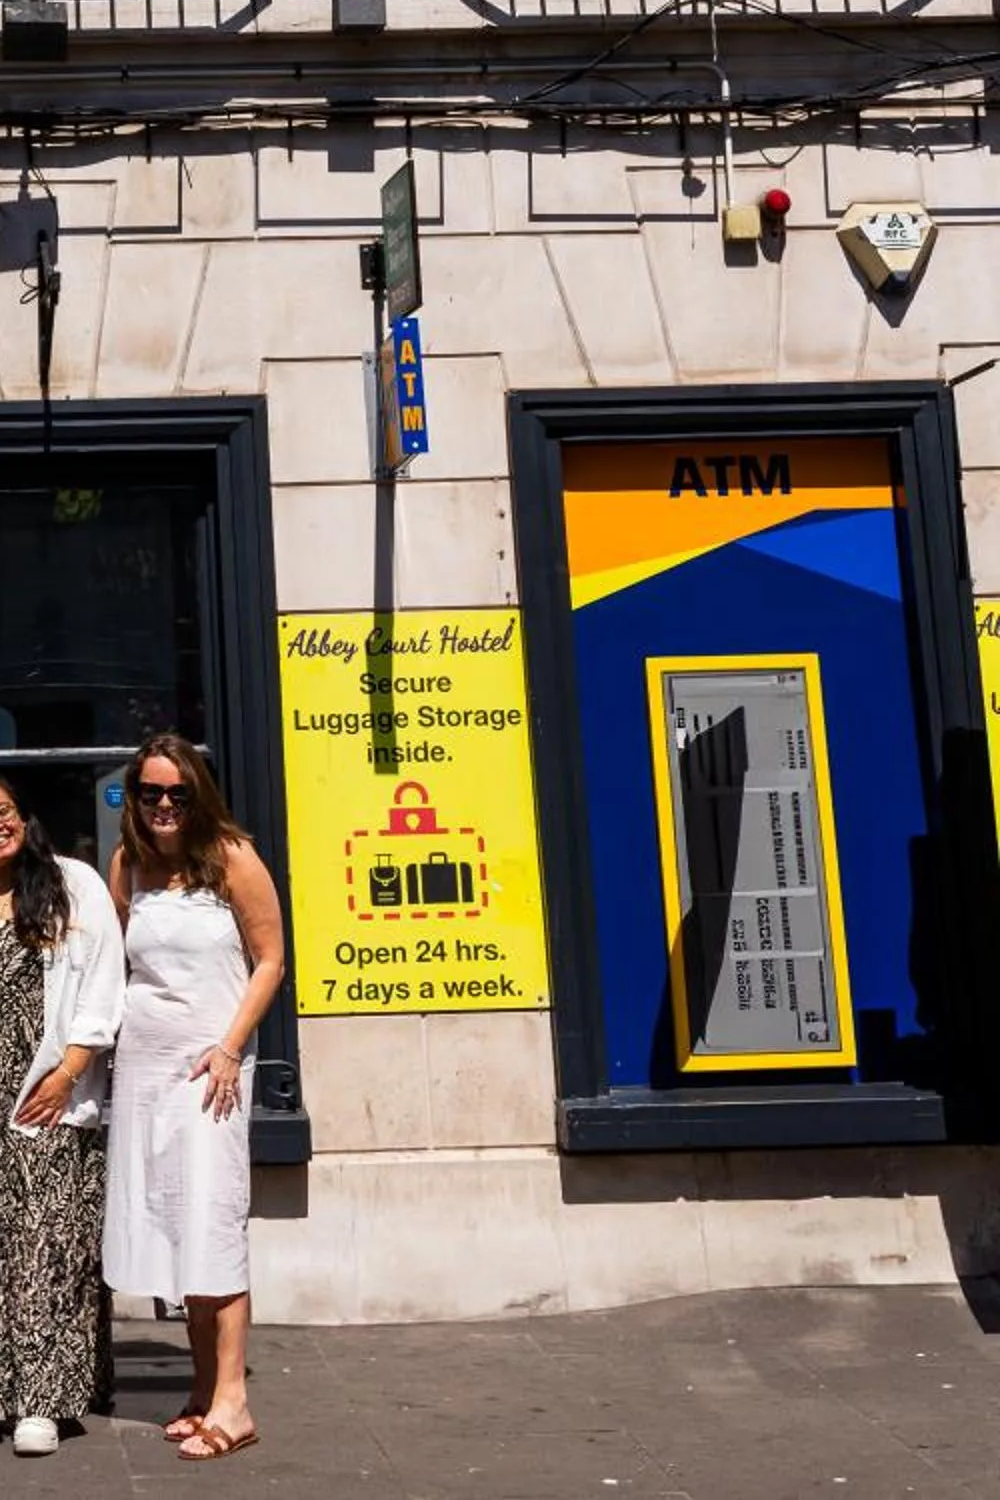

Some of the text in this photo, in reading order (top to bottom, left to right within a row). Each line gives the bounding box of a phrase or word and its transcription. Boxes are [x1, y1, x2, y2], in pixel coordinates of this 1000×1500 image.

[400, 340, 424, 431] ATM
[668, 452, 793, 498] ATM
[287, 621, 516, 663] Abbey Court Hostel
[360, 672, 452, 694] Secure
[294, 705, 522, 734] Luggage Storage
[367, 741, 453, 763] inside.
[335, 940, 506, 969] Open 24 hrs.
[322, 974, 524, 1005] 7 days a week.
